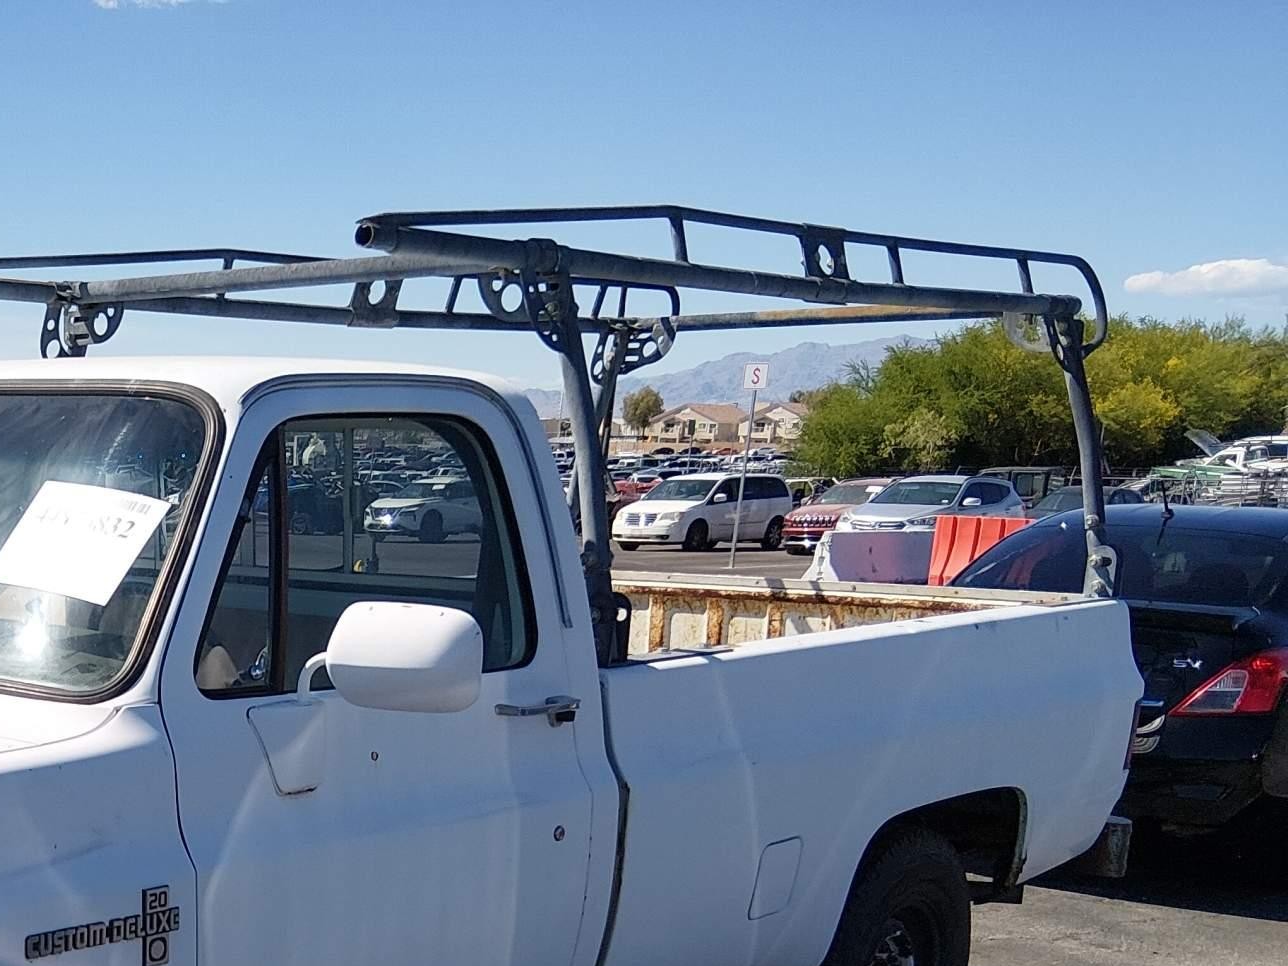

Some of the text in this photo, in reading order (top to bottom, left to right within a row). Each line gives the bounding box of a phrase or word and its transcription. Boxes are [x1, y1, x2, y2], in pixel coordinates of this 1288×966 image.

[751, 367, 761, 385] S
[1172, 658, 1203, 671] SV
[148, 890, 168, 911] 20
[25, 906, 180, 960] CUSTOM DELUXE
